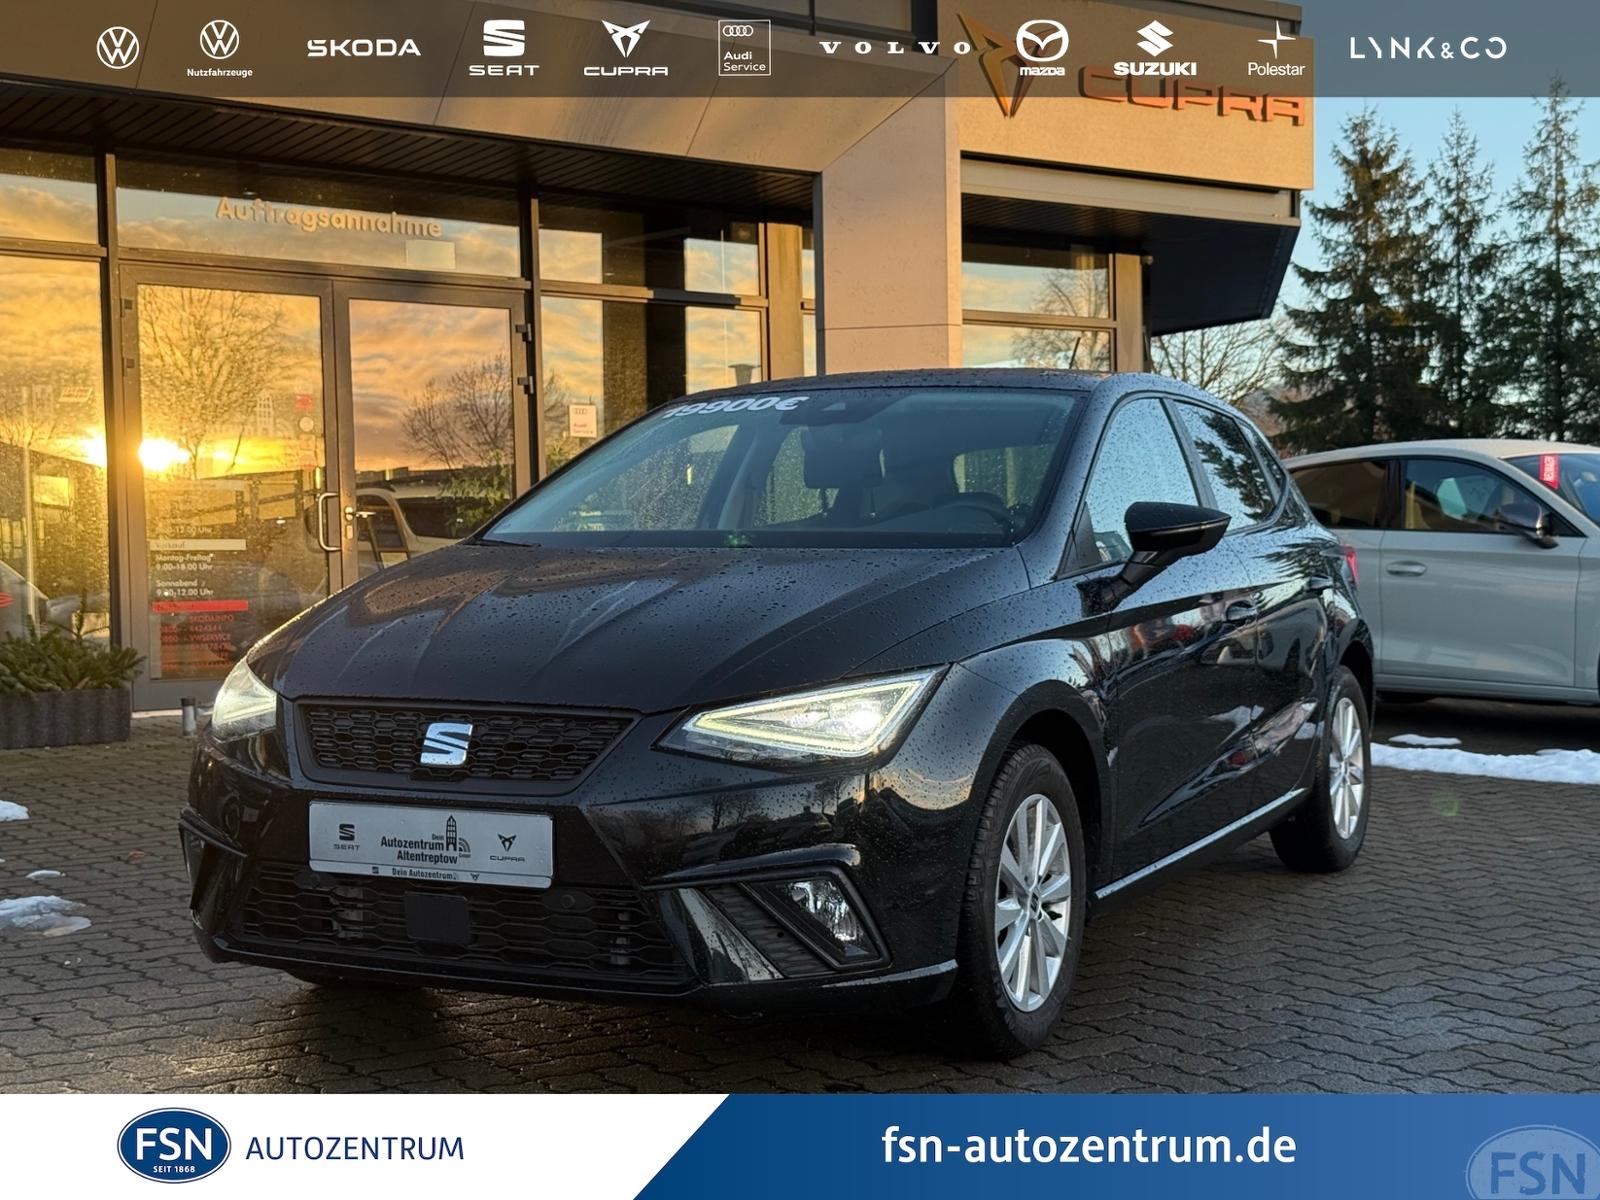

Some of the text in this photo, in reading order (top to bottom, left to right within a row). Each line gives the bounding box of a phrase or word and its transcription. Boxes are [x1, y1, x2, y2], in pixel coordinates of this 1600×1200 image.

[1078, 65, 1306, 127] CUPRA
[216, 196, 443, 237] Auftragsannahme
[156, 579, 198, 587] Sonnabend
[199, 588, 214, 596] Uhr
[333, 843, 361, 851] SEAT
[381, 835, 445, 851] Autozentrum
[397, 850, 458, 865] Altentreptow
[489, 855, 526, 863] CUPRA
[391, 866, 407, 876] Dein
